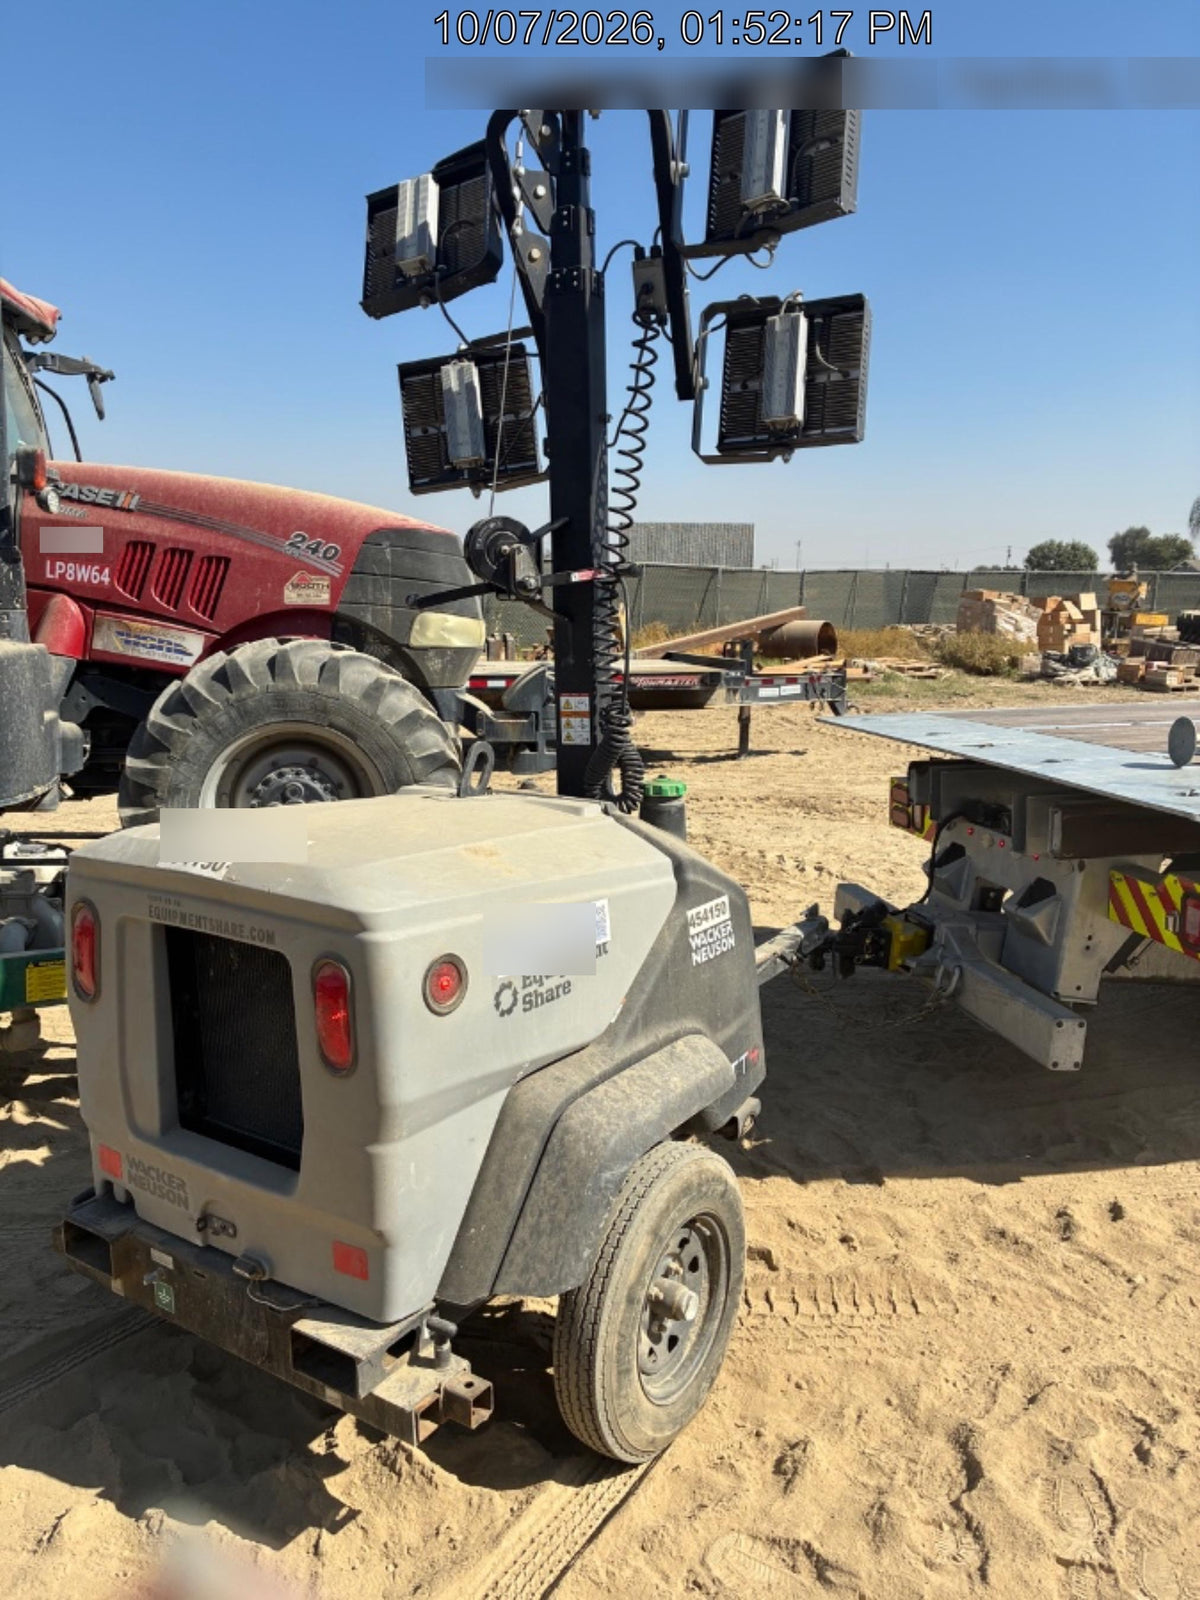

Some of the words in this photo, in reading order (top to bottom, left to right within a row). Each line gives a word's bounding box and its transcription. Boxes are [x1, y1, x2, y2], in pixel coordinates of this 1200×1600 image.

[284, 531, 341, 560] 240
[46, 560, 111, 585] LP8W64
[148, 904, 276, 945] EQUIPMENTSHARE.COM
[688, 901, 727, 928] 454150
[688, 921, 733, 950] WACKER
[691, 933, 736, 967] NEUSON
[521, 979, 572, 1013] Share
[125, 1152, 188, 1196] WACKER
[127, 1168, 189, 1211] NEUSON
